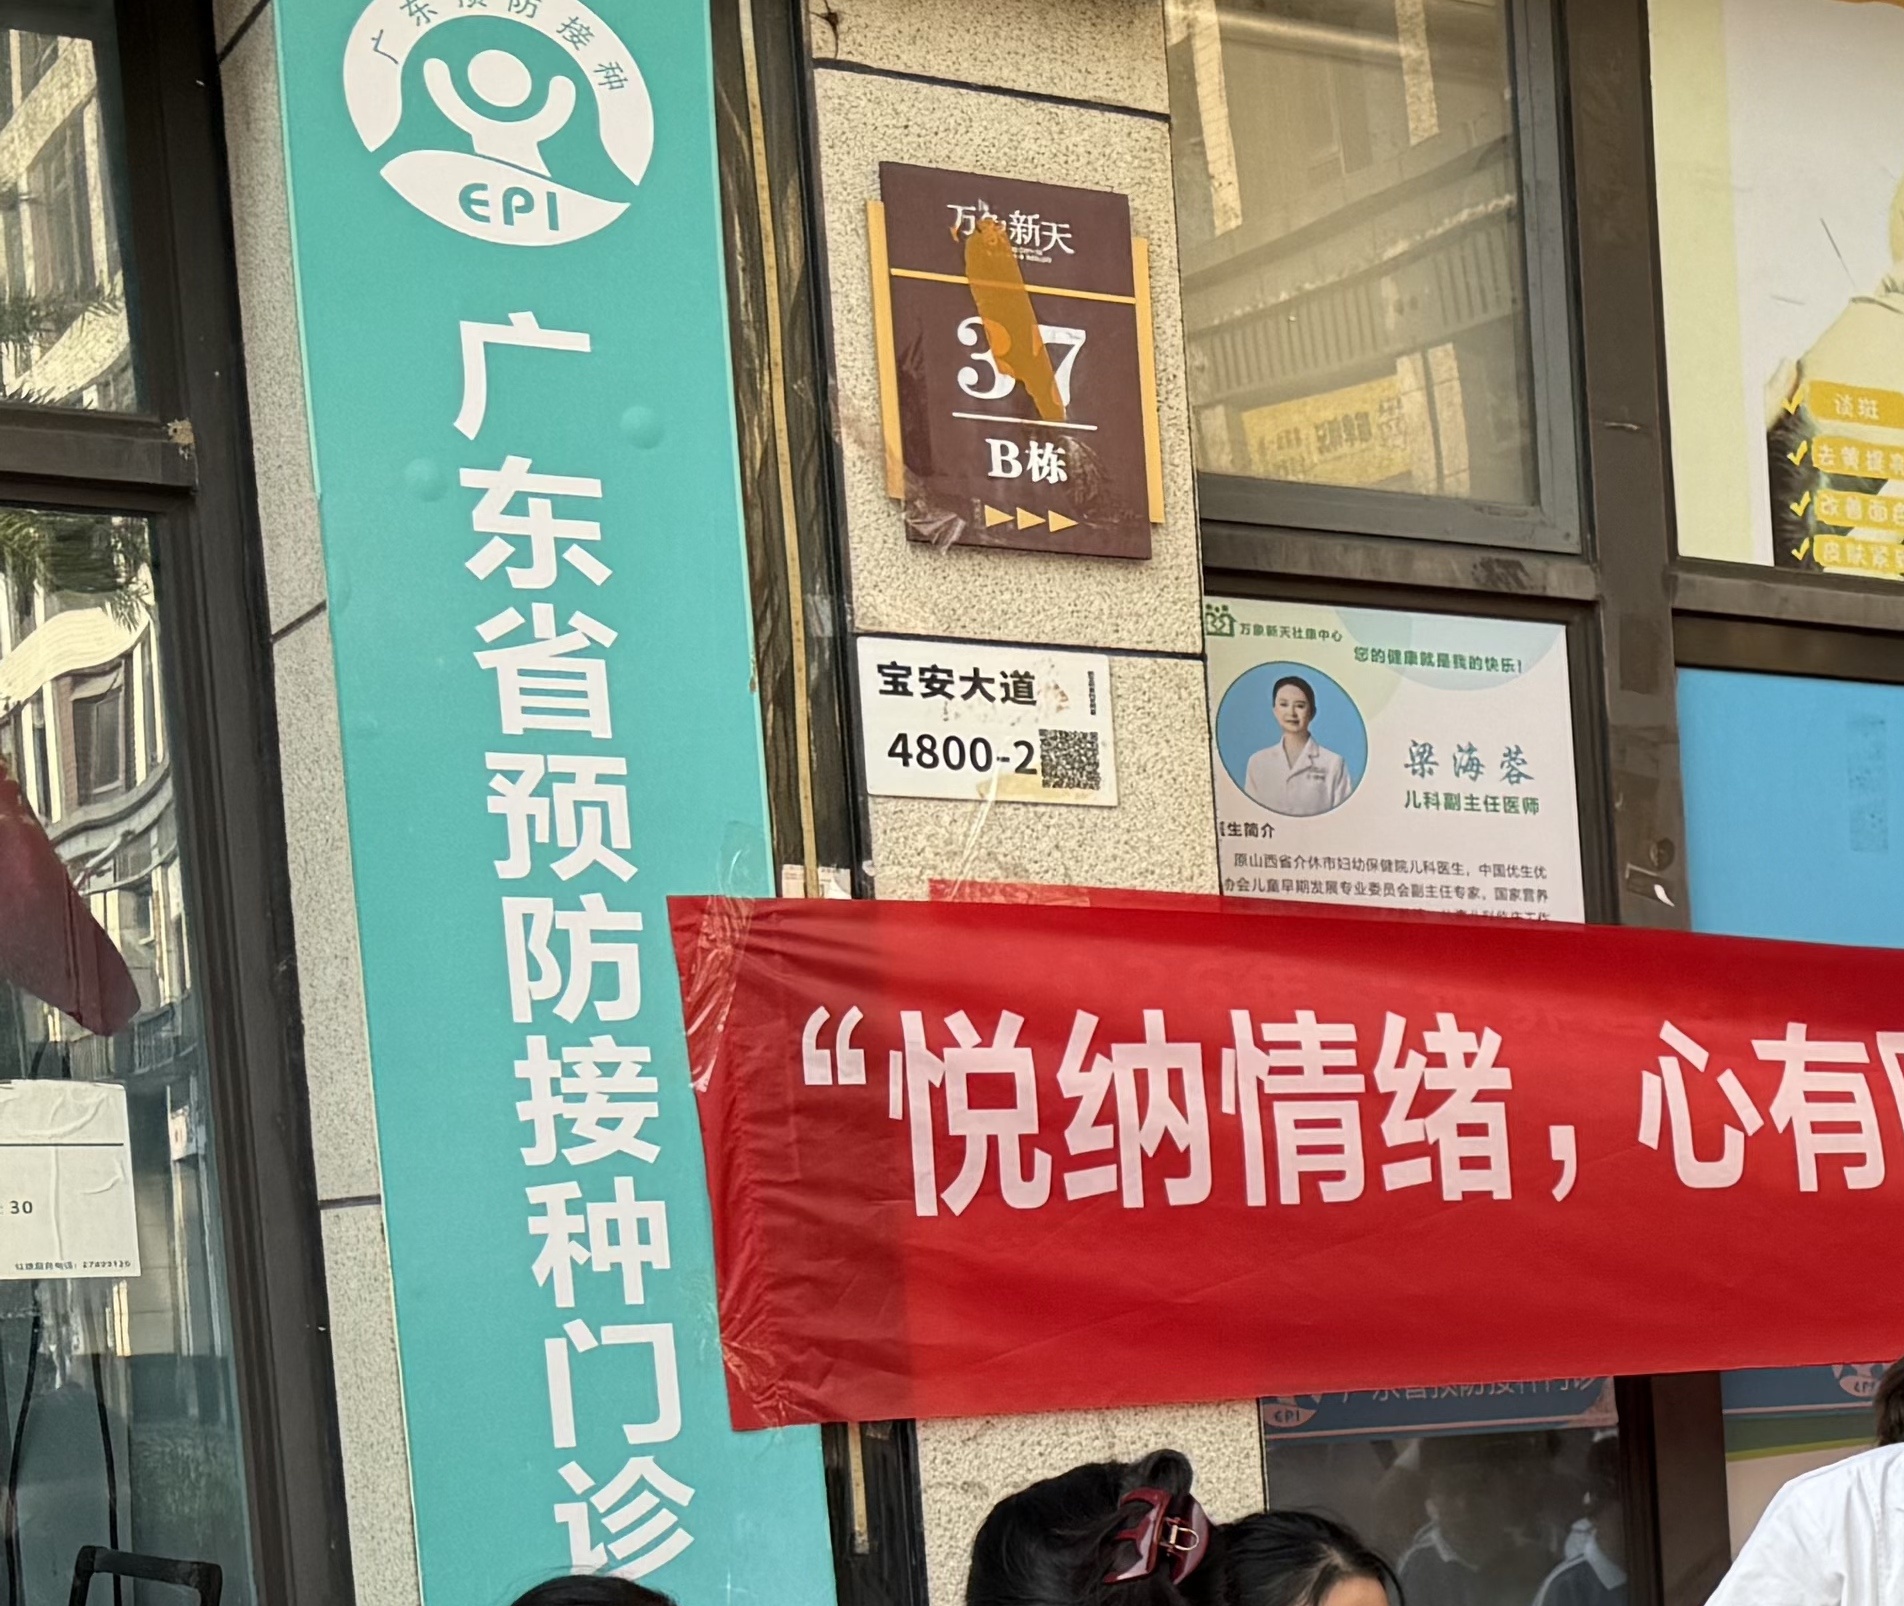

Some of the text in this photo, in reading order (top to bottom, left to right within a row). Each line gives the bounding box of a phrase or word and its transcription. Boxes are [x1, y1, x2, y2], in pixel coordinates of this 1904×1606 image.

[371, 0, 628, 90] 广东防接种
[458, 183, 560, 231] EPI
[957, 317, 1087, 408] 37
[985, 438, 1068, 484] B栋
[876, 660, 1037, 706] 宝安大道
[887, 732, 1038, 776] 4800-2
[1403, 739, 1535, 786] 梁海蓉
[1403, 790, 1540, 815] 儿科副主任医师
[452, 311, 696, 1577] 广东省预防接种门诊
